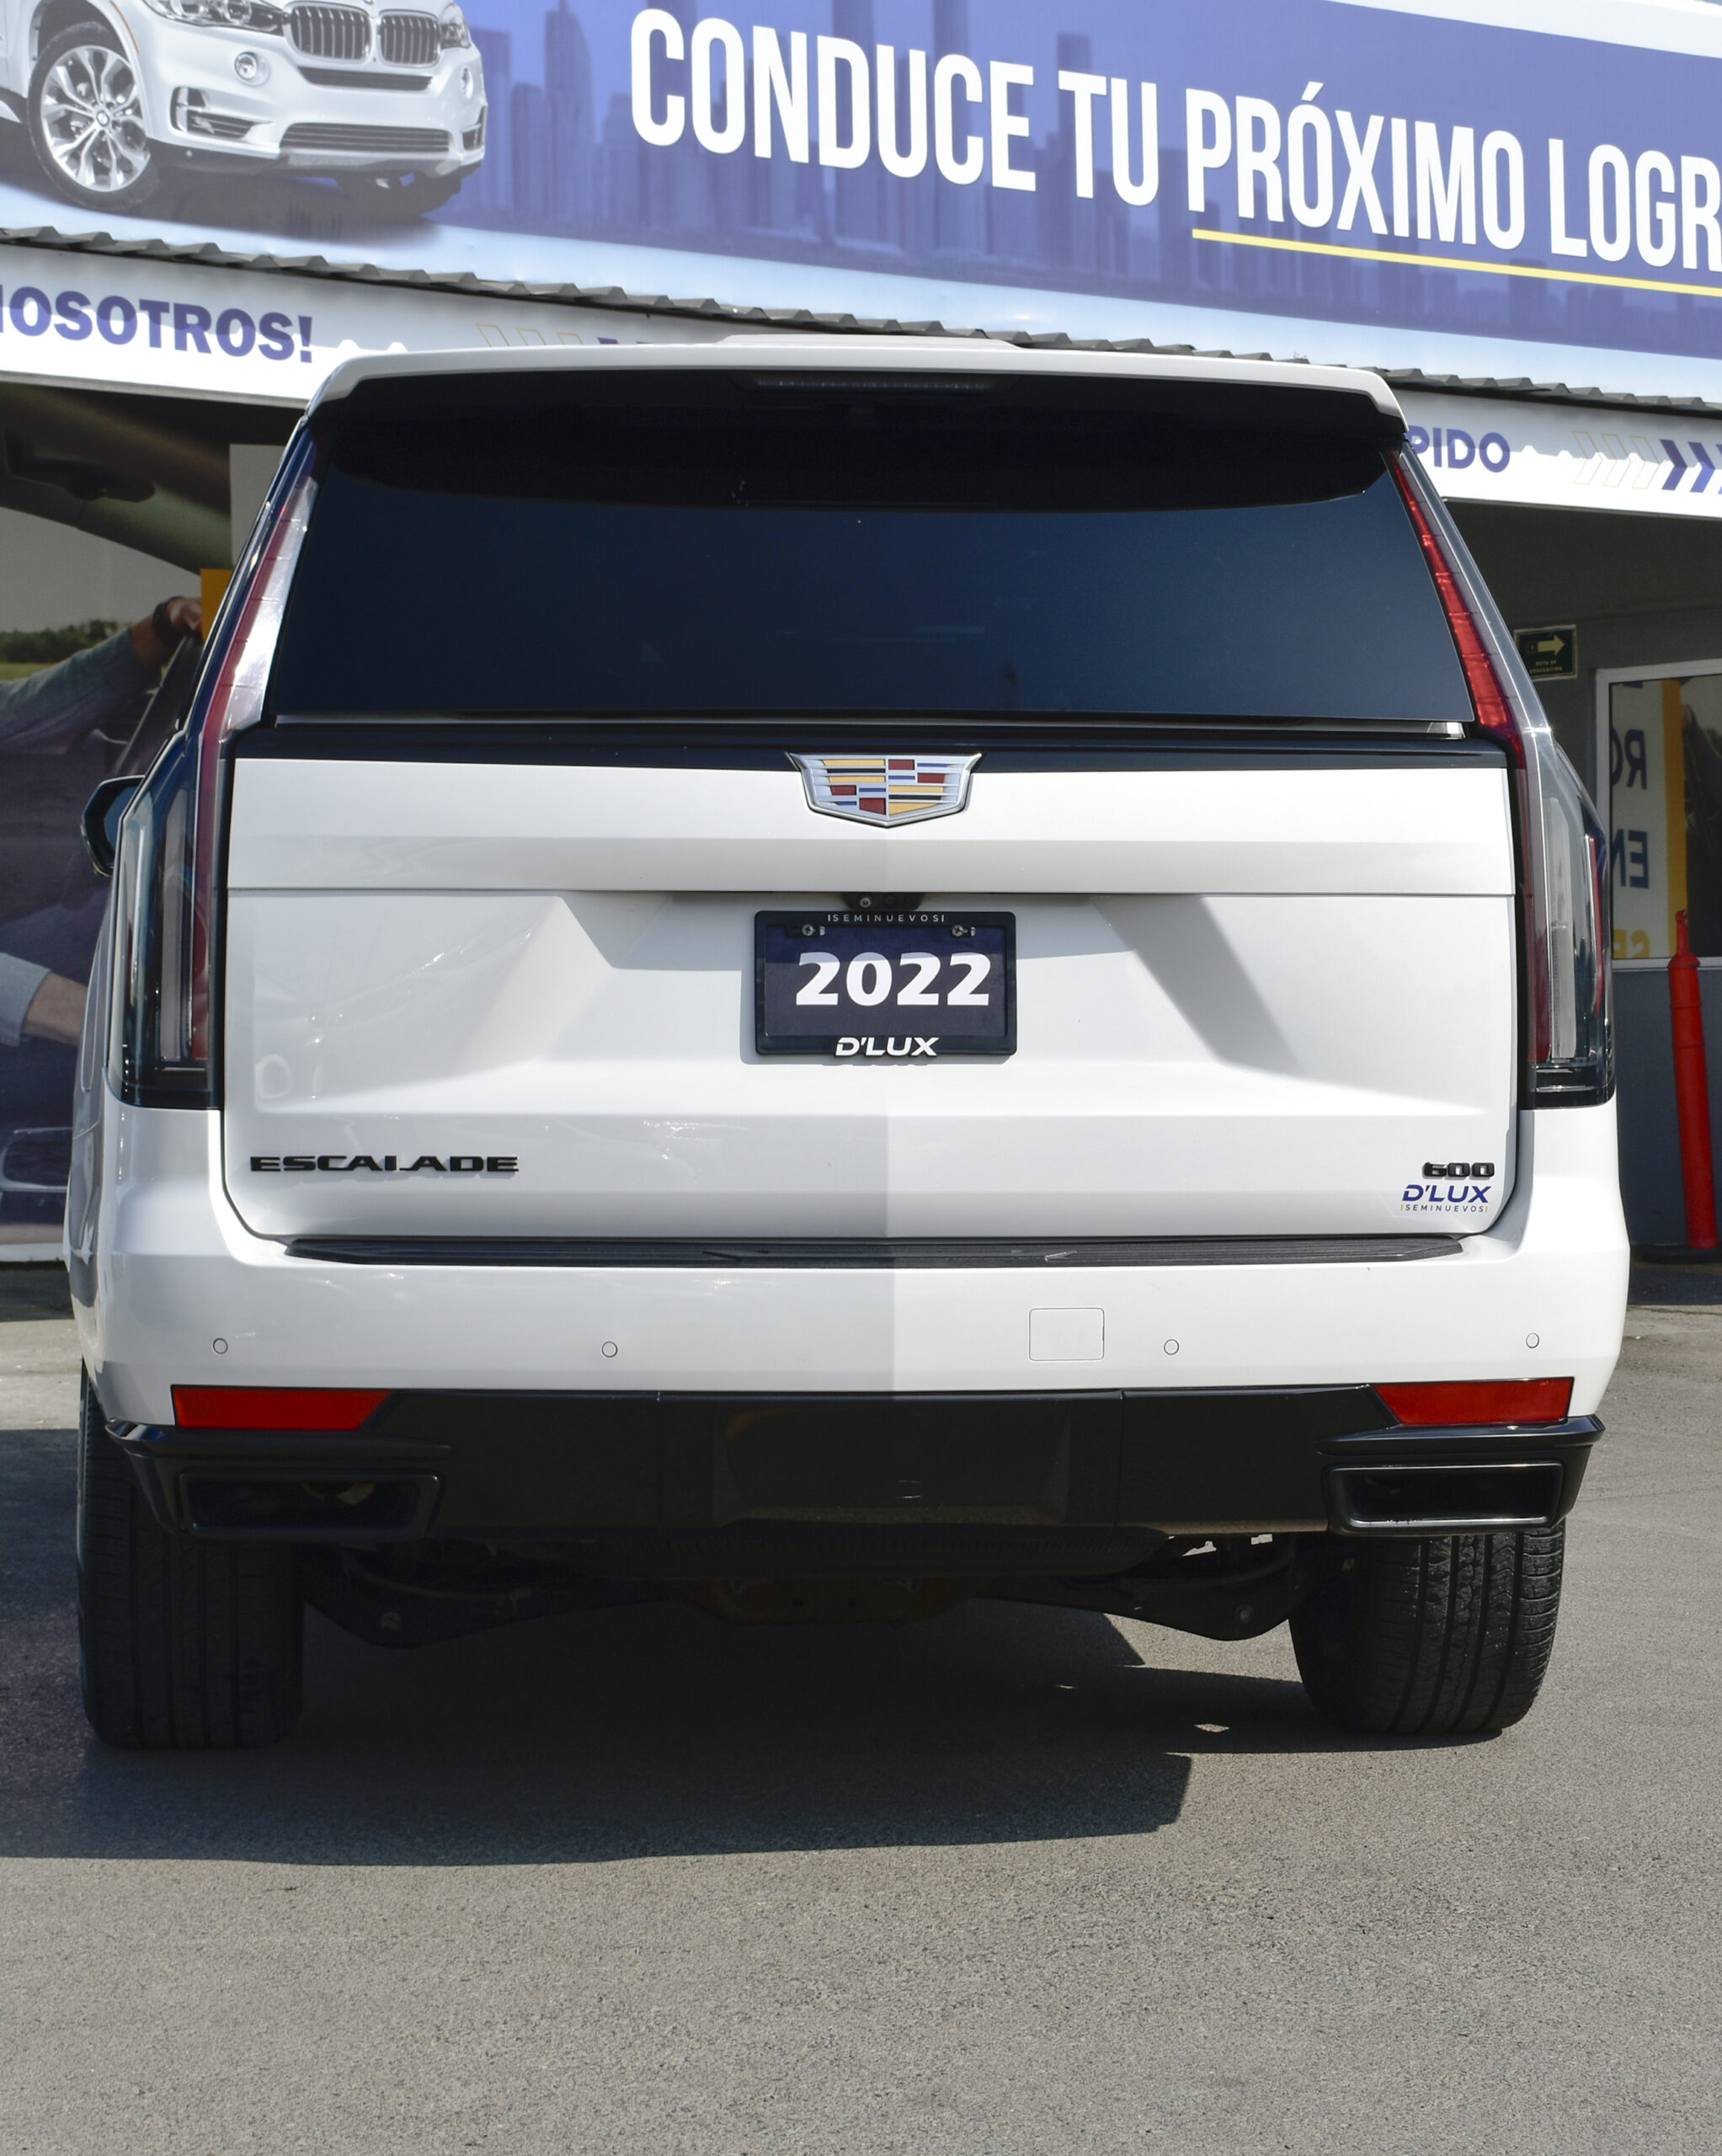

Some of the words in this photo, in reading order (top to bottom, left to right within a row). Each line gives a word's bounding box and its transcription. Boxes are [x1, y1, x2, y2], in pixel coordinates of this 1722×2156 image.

[631, 8, 1037, 192] CONDUCE
[1058, 69, 1160, 207] TU
[1185, 80, 1526, 251] PRÓXIMO
[1548, 136, 1722, 272] LOGR
[0, 284, 313, 363] OSOTROS!
[795, 951, 992, 1007] 2022
[834, 1037, 940, 1057] D'LUX
[250, 1155, 520, 1172] ESCALADE
[1422, 1161, 1495, 1178] 600
[1402, 1184, 1491, 1203] D'LUX
